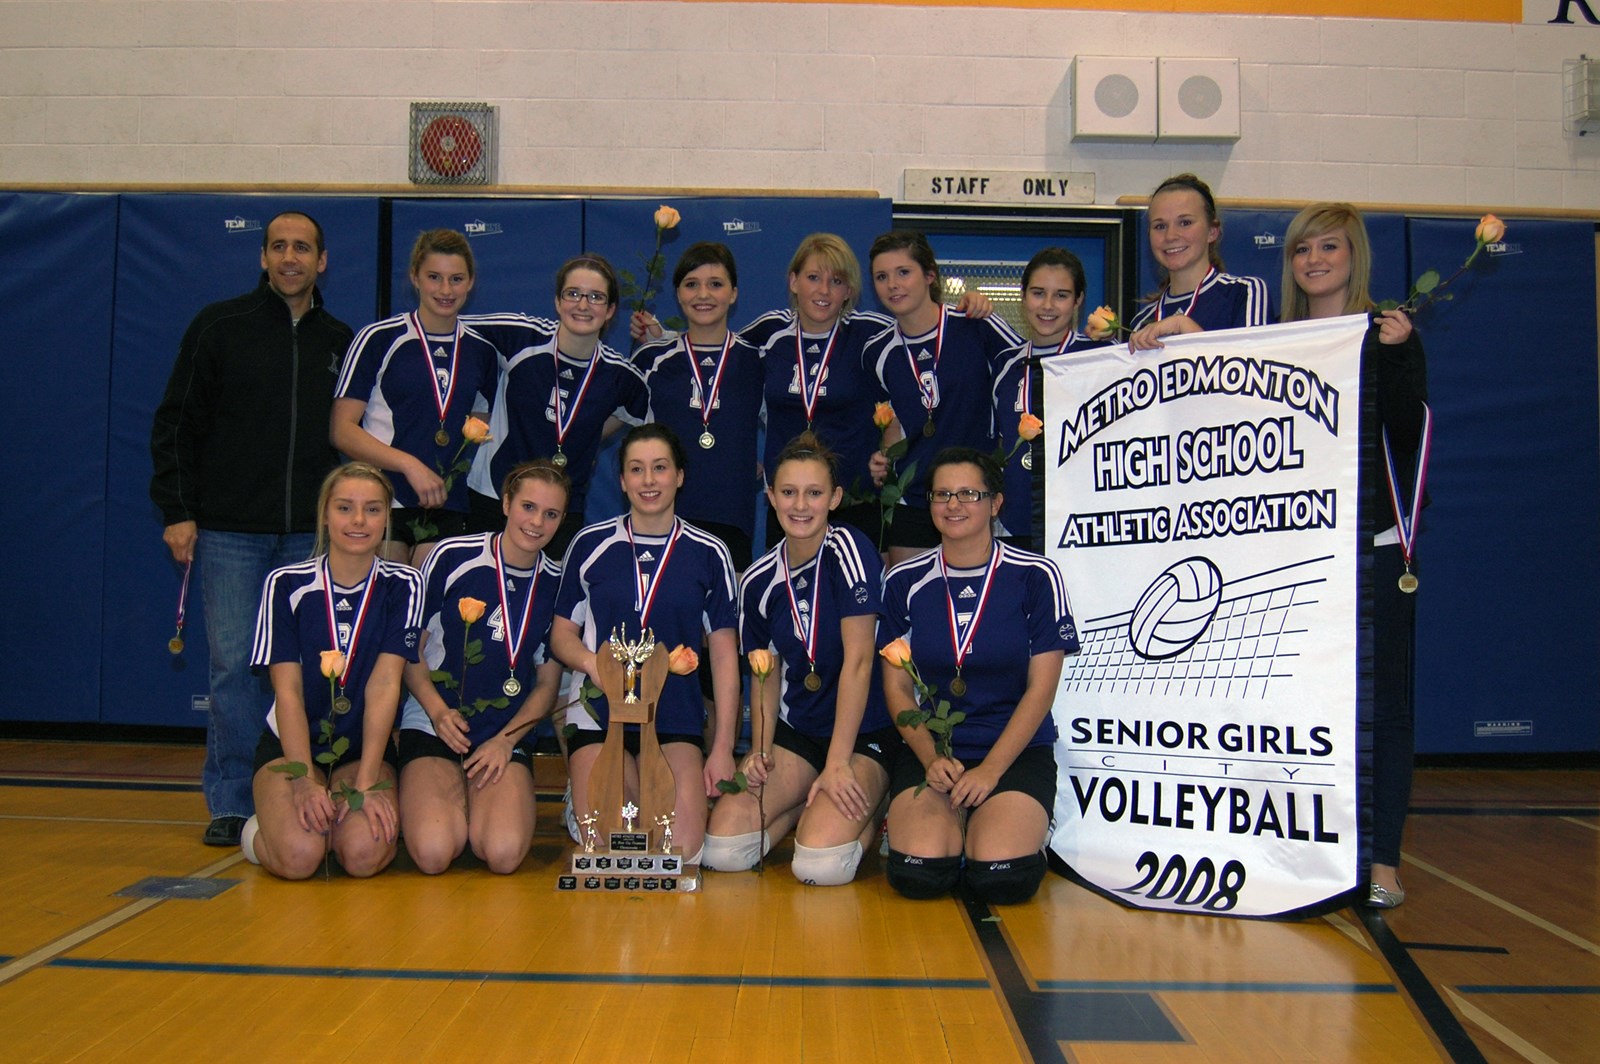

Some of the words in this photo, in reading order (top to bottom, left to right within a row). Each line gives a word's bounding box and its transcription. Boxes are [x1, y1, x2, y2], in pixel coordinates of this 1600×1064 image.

[931, 177, 990, 195] STAFF
[1023, 178, 1069, 196] ONLY
[545, 387, 569, 423] 5
[1057, 368, 1158, 467] METRO
[1159, 355, 1340, 437] EDMONTON
[1093, 434, 1171, 491] HIGH
[1176, 416, 1304, 484] SCHOOL
[1057, 506, 1171, 548] ATHLETIC
[1171, 488, 1337, 541] ASSOCIATION
[487, 604, 505, 641] 4
[1070, 717, 1209, 750] SENIOR
[1217, 722, 1334, 757] GIRLS
[1101, 754, 1301, 781] CITY
[1068, 775, 1340, 844] VOLLEYBALL
[1112, 851, 1247, 912] 2008
